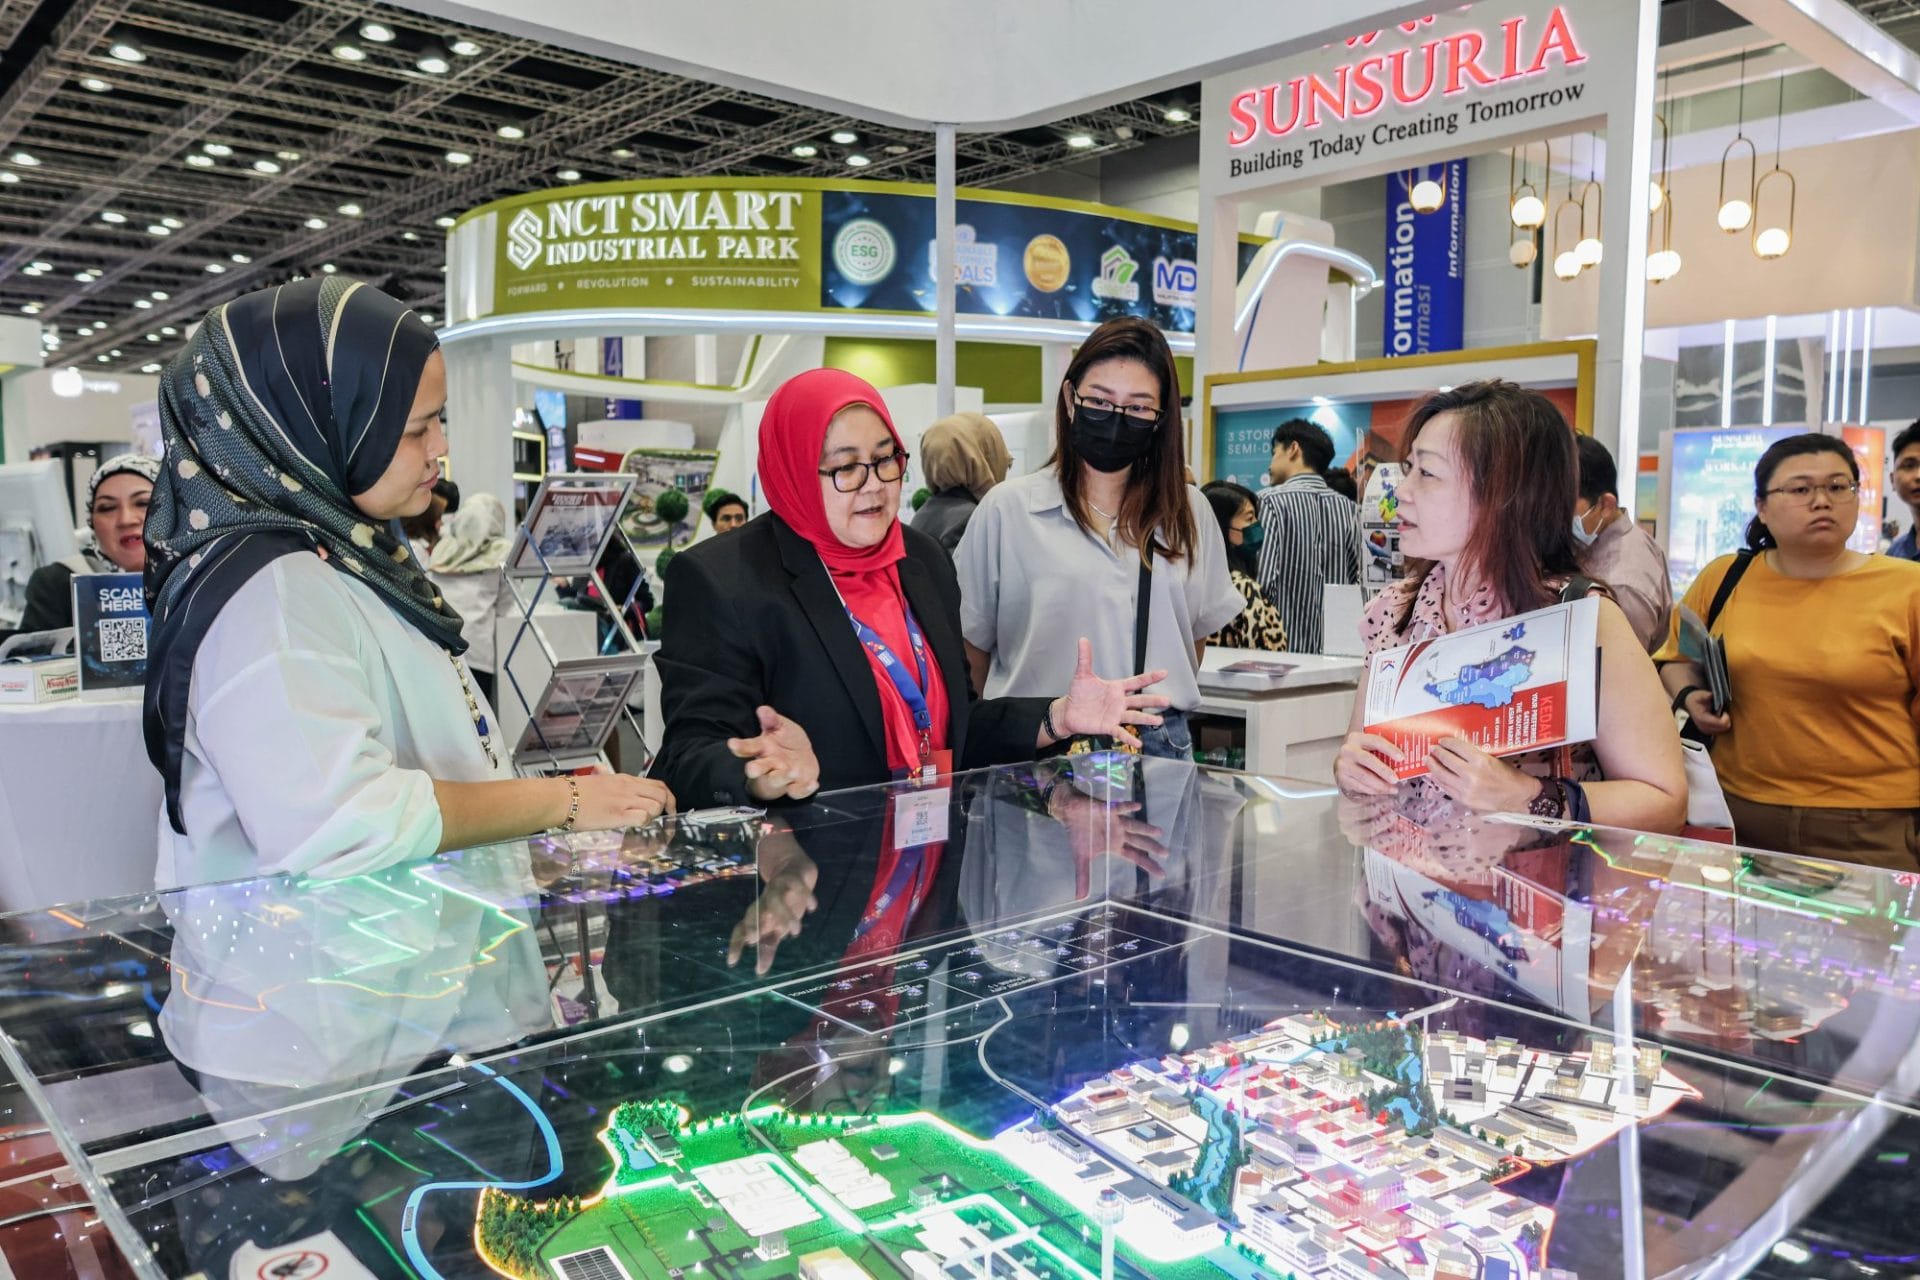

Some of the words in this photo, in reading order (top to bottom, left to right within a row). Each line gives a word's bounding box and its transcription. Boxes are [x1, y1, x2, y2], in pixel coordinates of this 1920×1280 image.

[1228, 7, 1586, 146] SUNSURIA
[1230, 148, 1303, 178] Building
[1309, 132, 1366, 160] Today
[1372, 113, 1459, 145] Creating
[1466, 82, 1585, 126] Tomorrow
[546, 195, 626, 240] NCT
[631, 190, 802, 232] SMART
[1448, 163, 1461, 278] Information
[546, 237, 706, 266] INDUSTRIAL
[717, 237, 800, 260] PARK
[851, 244, 879, 258] ESG
[507, 282, 548, 297] FORWARD
[576, 277, 649, 289] REVOLUTION
[691, 275, 800, 288] SUSTAINABILITY
[1386, 201, 1415, 357] ormation
[99, 587, 143, 600] SCAN
[101, 600, 143, 612] HERE
[1539, 696, 1553, 740] KEDAH
